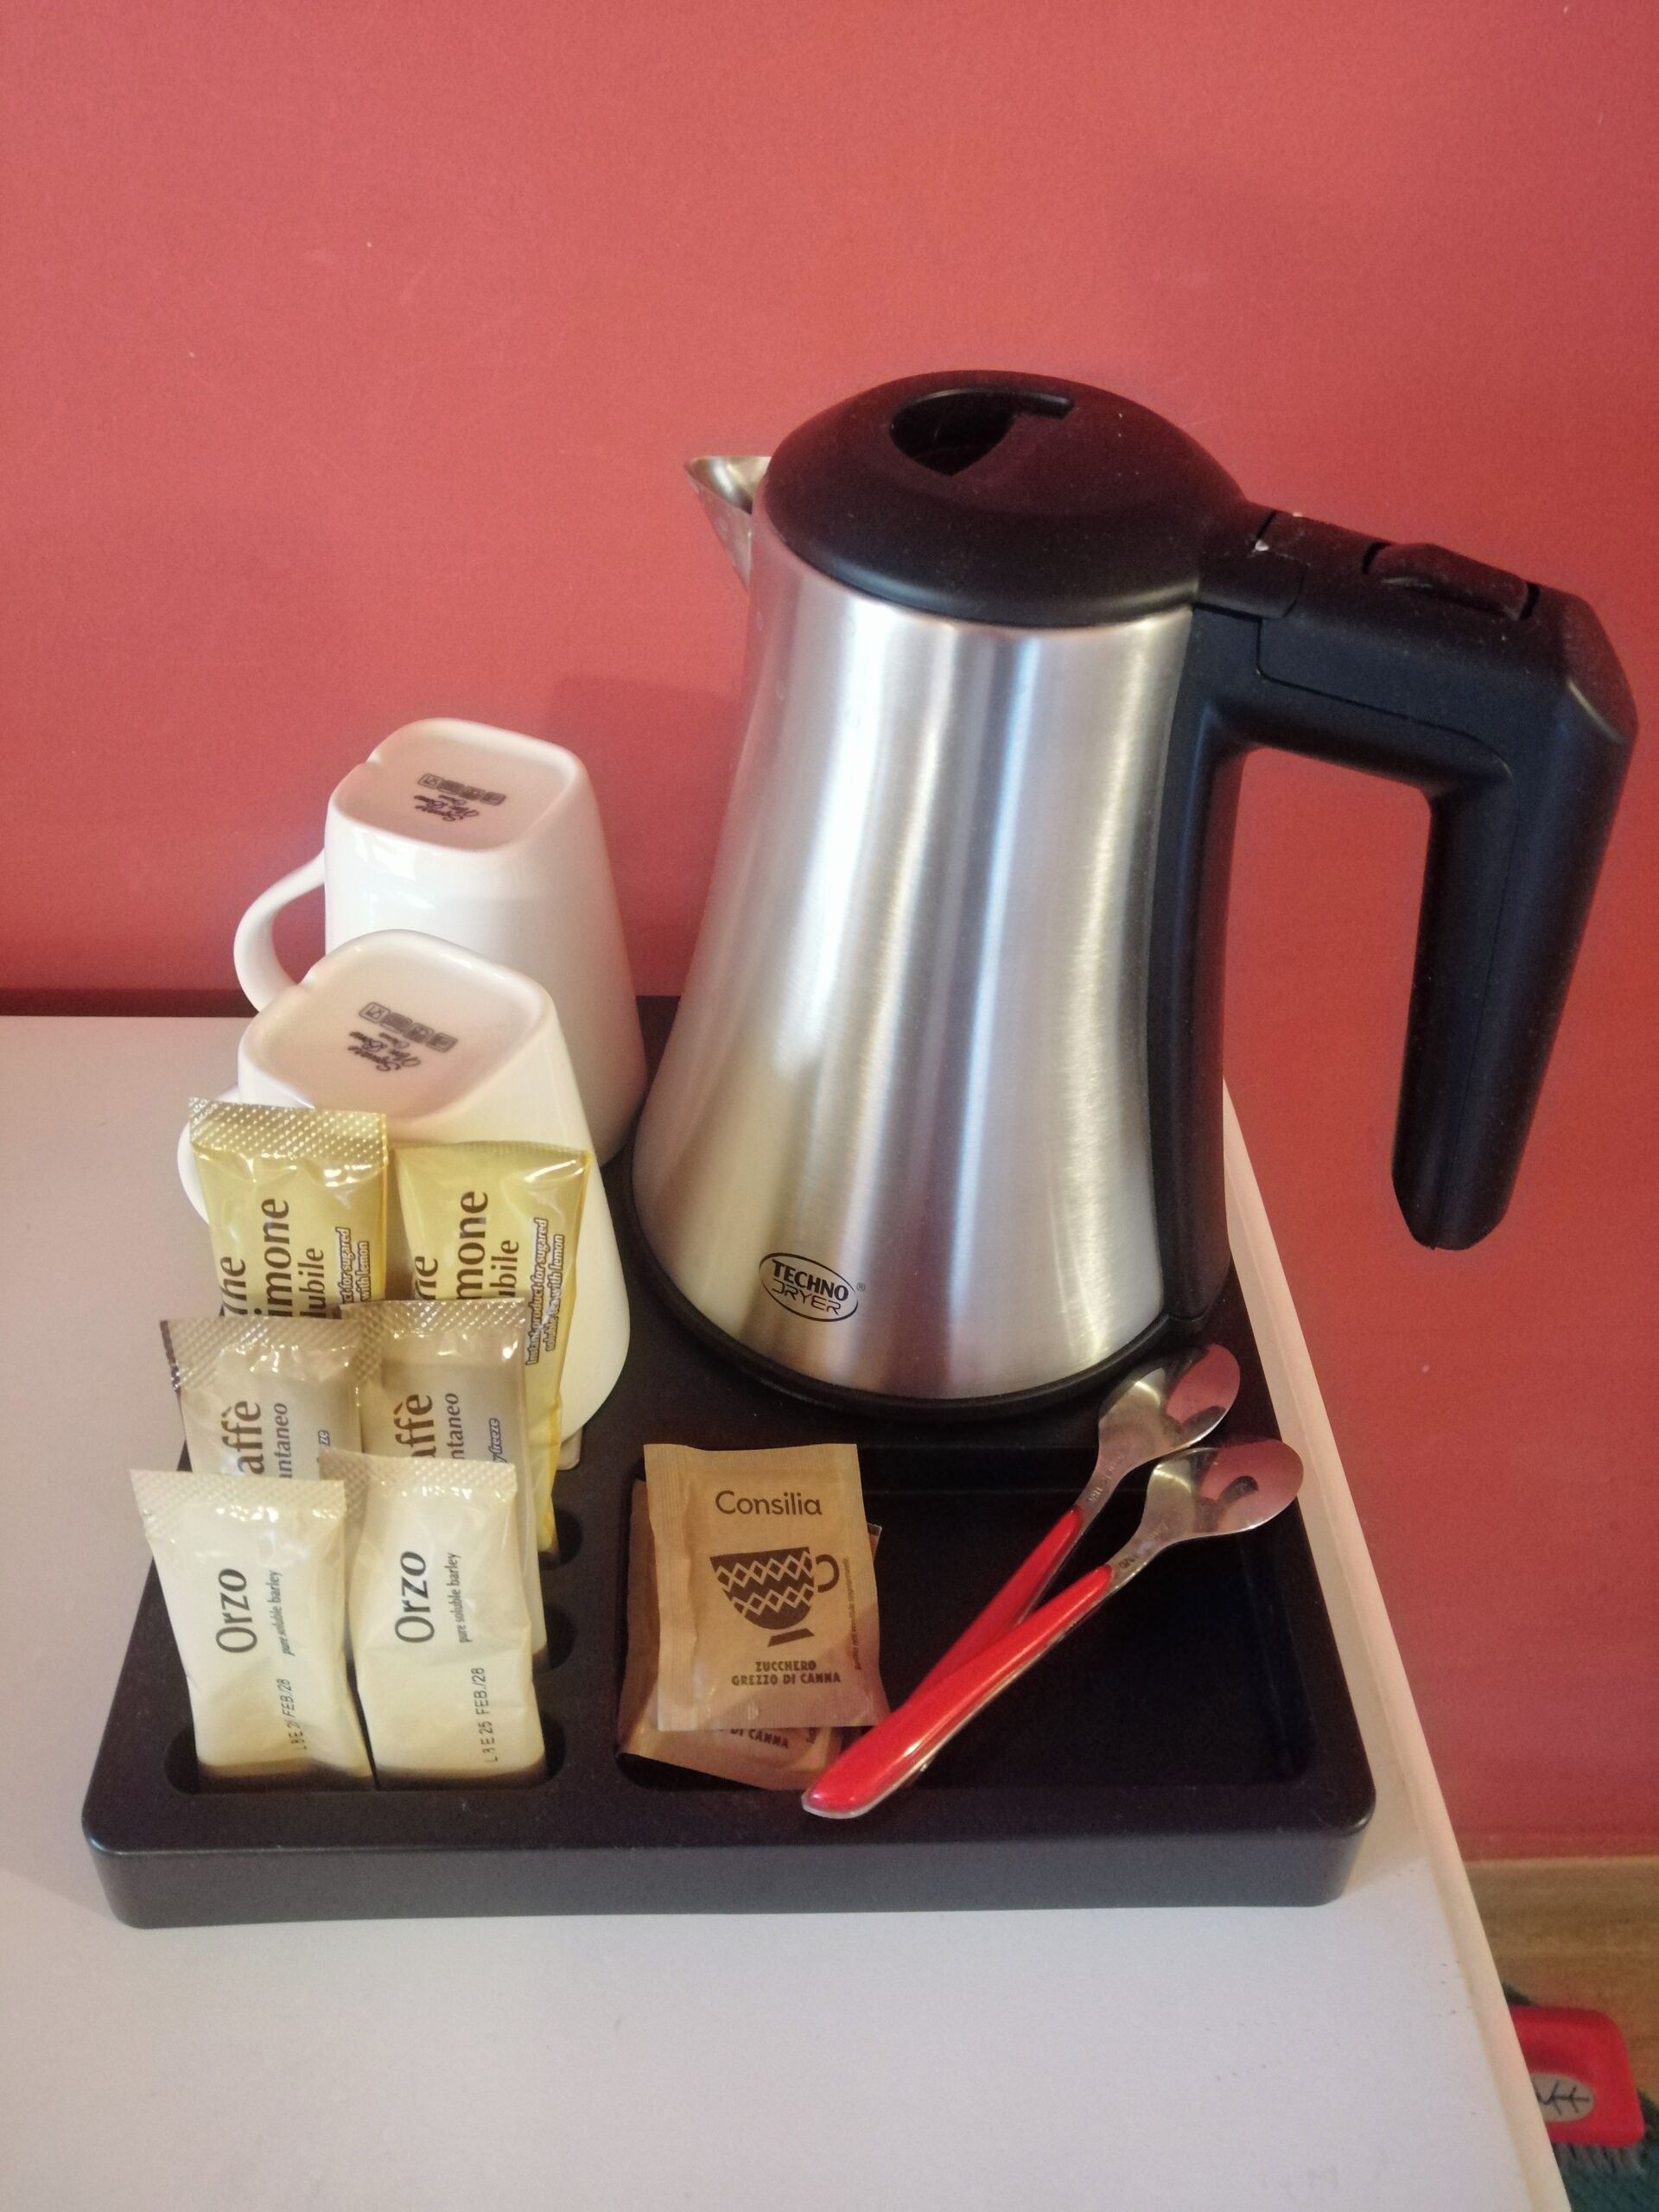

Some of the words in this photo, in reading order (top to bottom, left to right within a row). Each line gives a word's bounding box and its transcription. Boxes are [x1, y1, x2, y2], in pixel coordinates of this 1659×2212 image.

[254, 1198, 293, 1317] imone
[335, 1226, 355, 1272] sugared
[355, 1241, 371, 1276] lemon
[456, 1191, 488, 1300] mone
[533, 1217, 551, 1264] sugared
[549, 1234, 565, 1270] lemon
[297, 1248, 327, 1318] lubile
[338, 1273, 354, 1288] for
[355, 1275, 372, 1301] with
[530, 1266, 546, 1284] for
[547, 1271, 563, 1298] with
[772, 1259, 849, 1301] TECHNO
[528, 1285, 544, 1329] product
[772, 1278, 842, 1315] DRYER
[525, 1329, 541, 1366] Instant
[221, 1401, 265, 1474] affè
[274, 1402, 293, 1478] ntaneo
[445, 1393, 466, 1459] ntaneo
[488, 1418, 503, 1454] freeze
[715, 1490, 823, 1516] Consilia
[266, 1570, 283, 1605] barley
[445, 1553, 461, 1586] barley
[216, 1568, 257, 1653] Orzo
[395, 1551, 435, 1643] Orzo
[447, 1588, 463, 1624] soluble
[454, 1624, 473, 1643] pure
[731, 1675, 778, 1686] GREZZO
[783, 1674, 796, 1684] DI
[800, 1672, 841, 1684] CANNA
[755, 1660, 817, 1672] ZUCCHERO
[748, 1728, 789, 1749] CANNA
